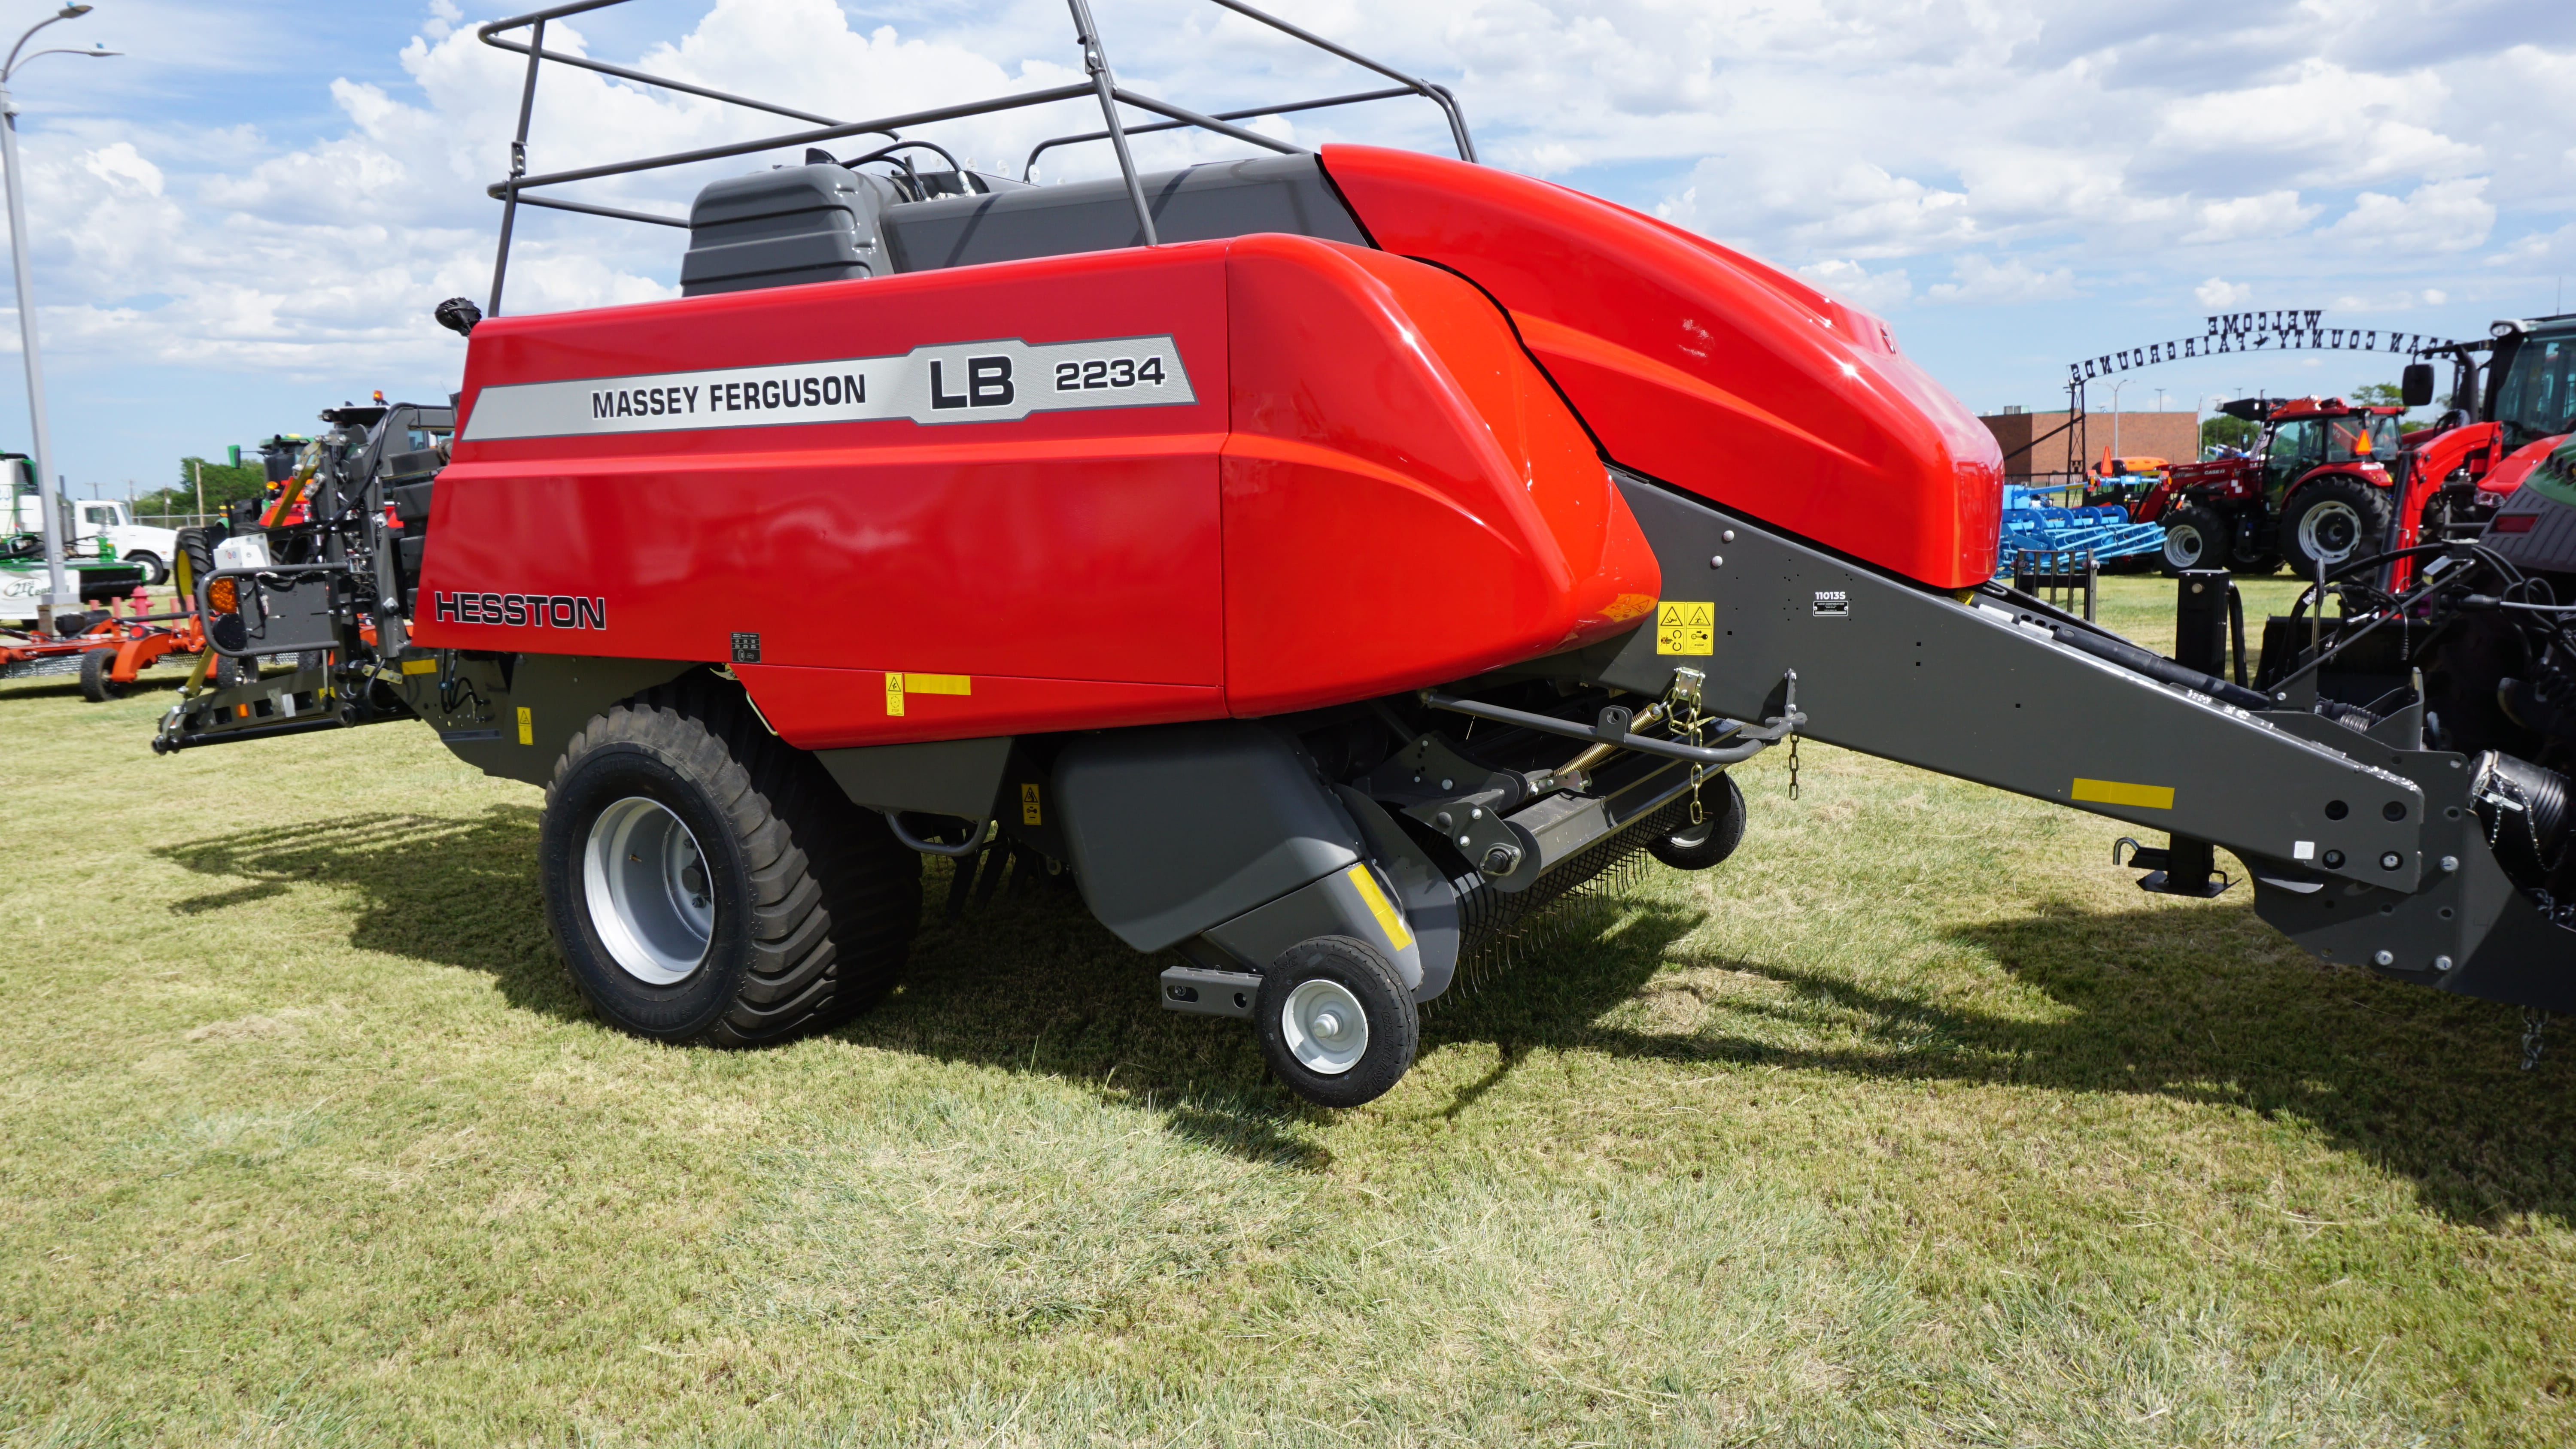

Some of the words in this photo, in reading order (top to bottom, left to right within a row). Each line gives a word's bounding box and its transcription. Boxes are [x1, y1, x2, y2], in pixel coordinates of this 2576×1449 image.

[592, 385, 699, 418] MASSEY
[710, 374, 866, 412] FERGUSON
[930, 355, 1014, 409] LB
[1055, 357, 1165, 391] 2234
[434, 591, 606, 630] HESSTON
